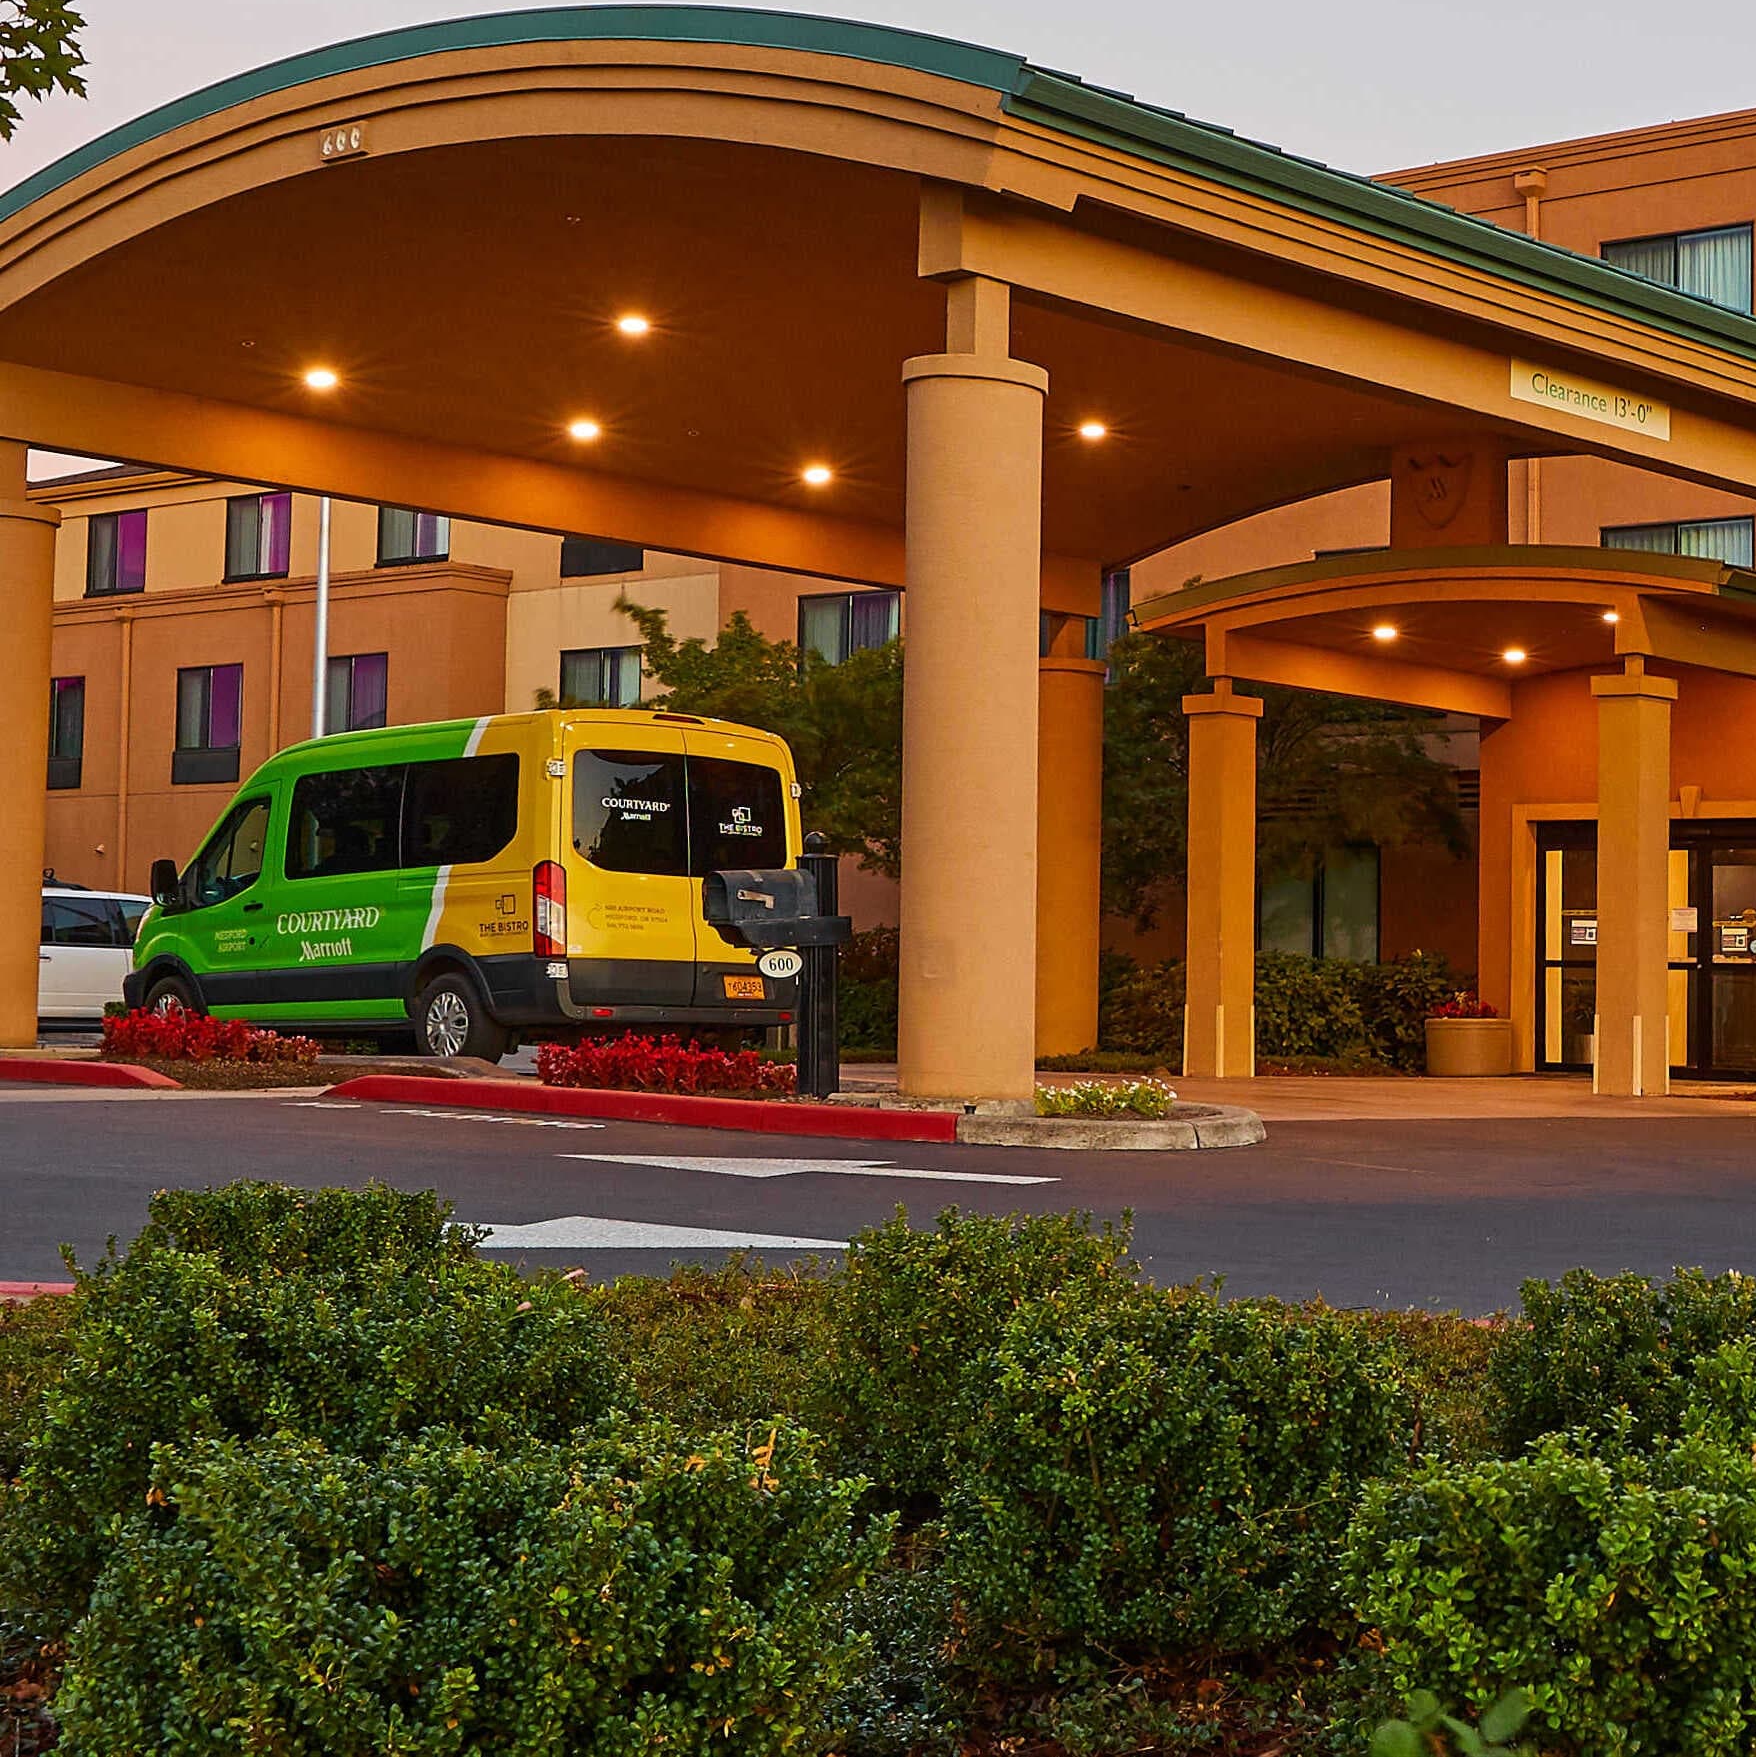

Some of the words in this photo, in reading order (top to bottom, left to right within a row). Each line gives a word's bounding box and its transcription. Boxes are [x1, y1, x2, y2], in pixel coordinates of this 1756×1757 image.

[1531, 372, 1608, 414] Clearance
[1613, 395, 1653, 424] 13'-0"
[601, 797, 668, 813] COURTYARD
[276, 906, 381, 936] COURTYARD
[479, 922, 496, 933] THE
[497, 920, 529, 933] BISTRO
[299, 937, 353, 962] Marriott
[768, 957, 794, 972] 600
